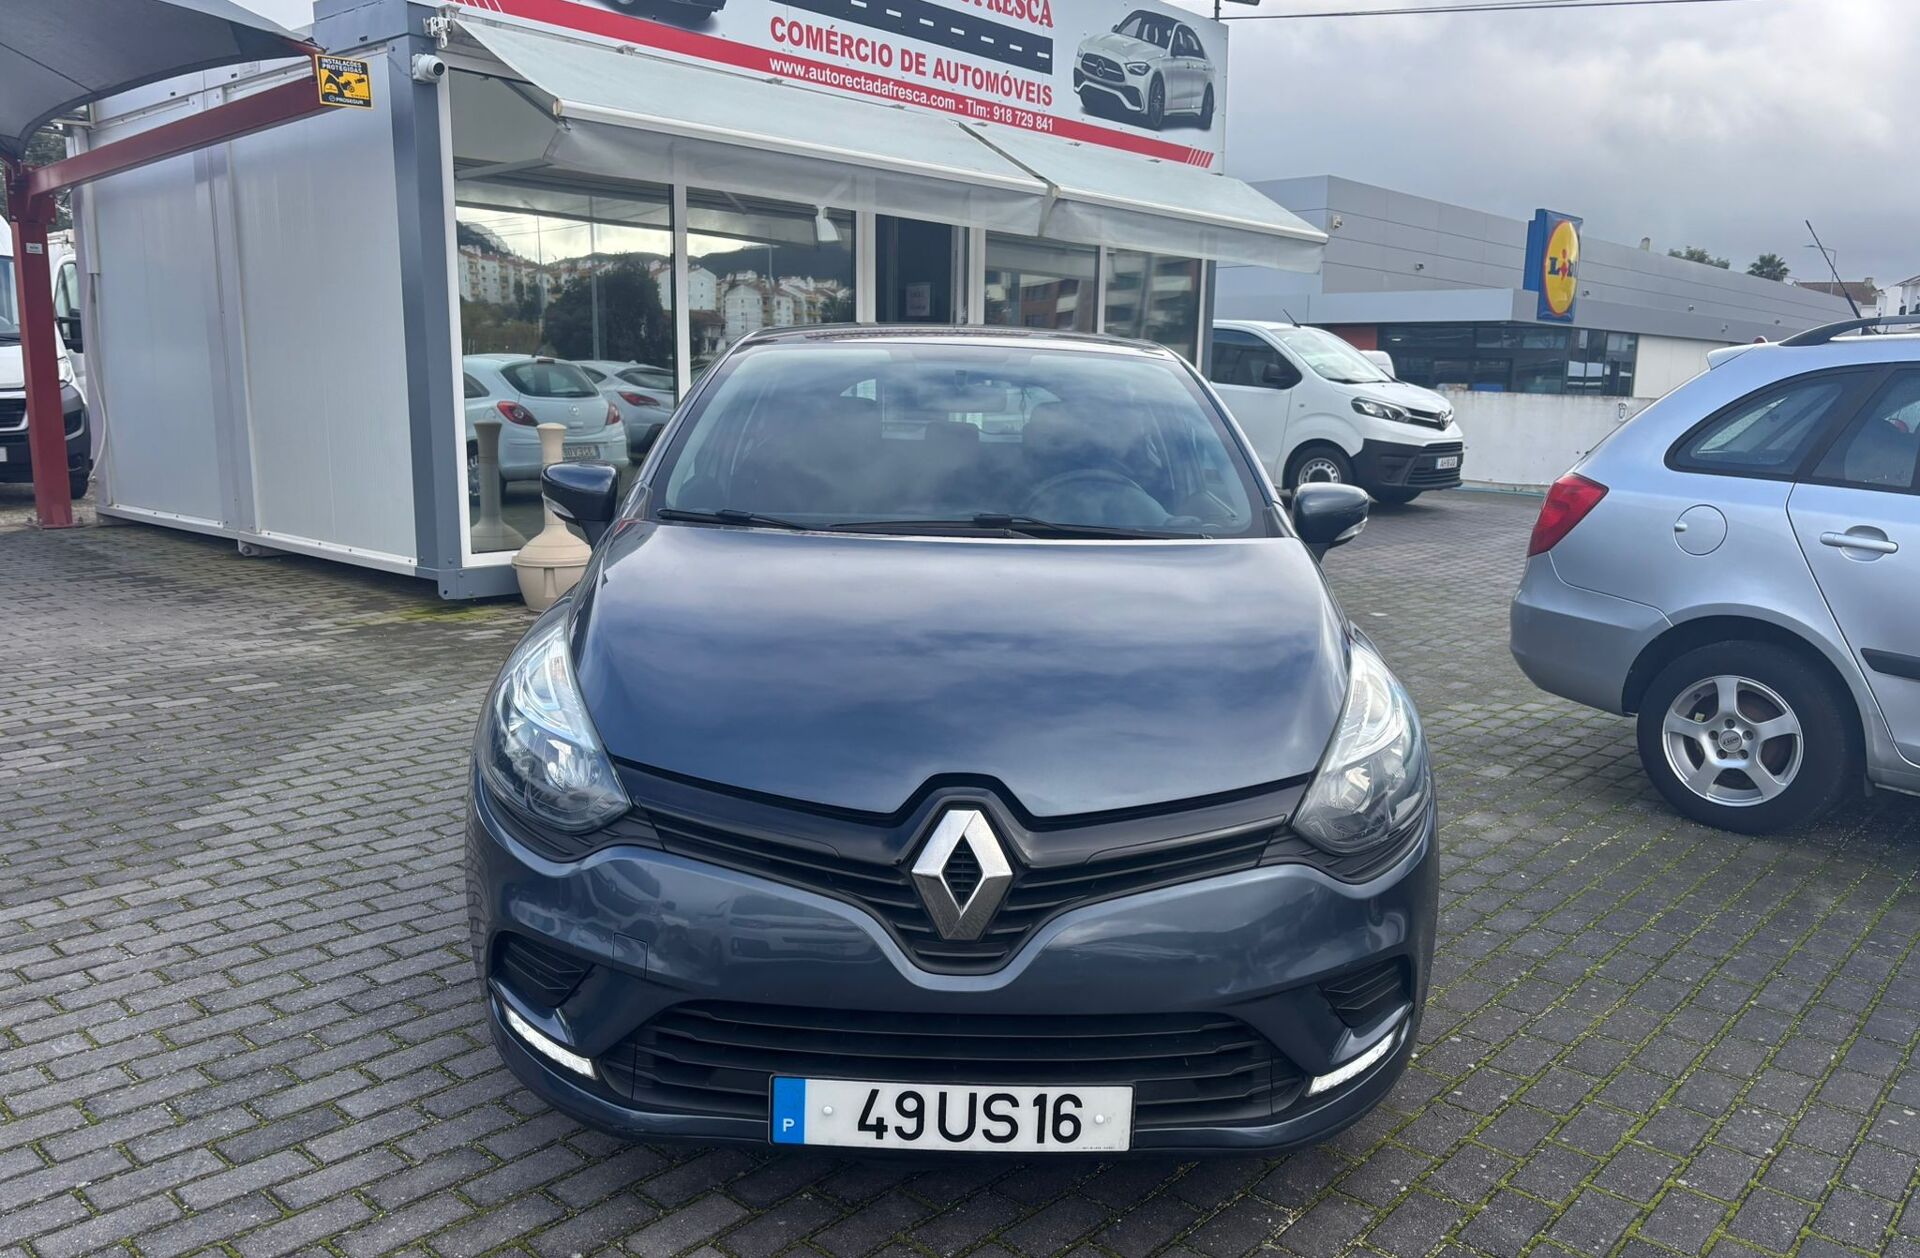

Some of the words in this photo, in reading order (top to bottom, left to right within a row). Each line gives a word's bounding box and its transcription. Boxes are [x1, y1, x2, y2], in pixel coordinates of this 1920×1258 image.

[974, 0, 1054, 28] ESCA
[770, 16, 893, 68] COMÉRCIO
[900, 48, 927, 77] DE
[932, 57, 1053, 107] AUTOMÓVEIS
[769, 57, 956, 110] www.autorectadafresca.com
[966, 99, 990, 118] Tlm:
[993, 105, 1012, 123] 918
[1015, 110, 1034, 128] 729
[1036, 115, 1054, 132] 841
[783, 1119, 795, 1132] P
